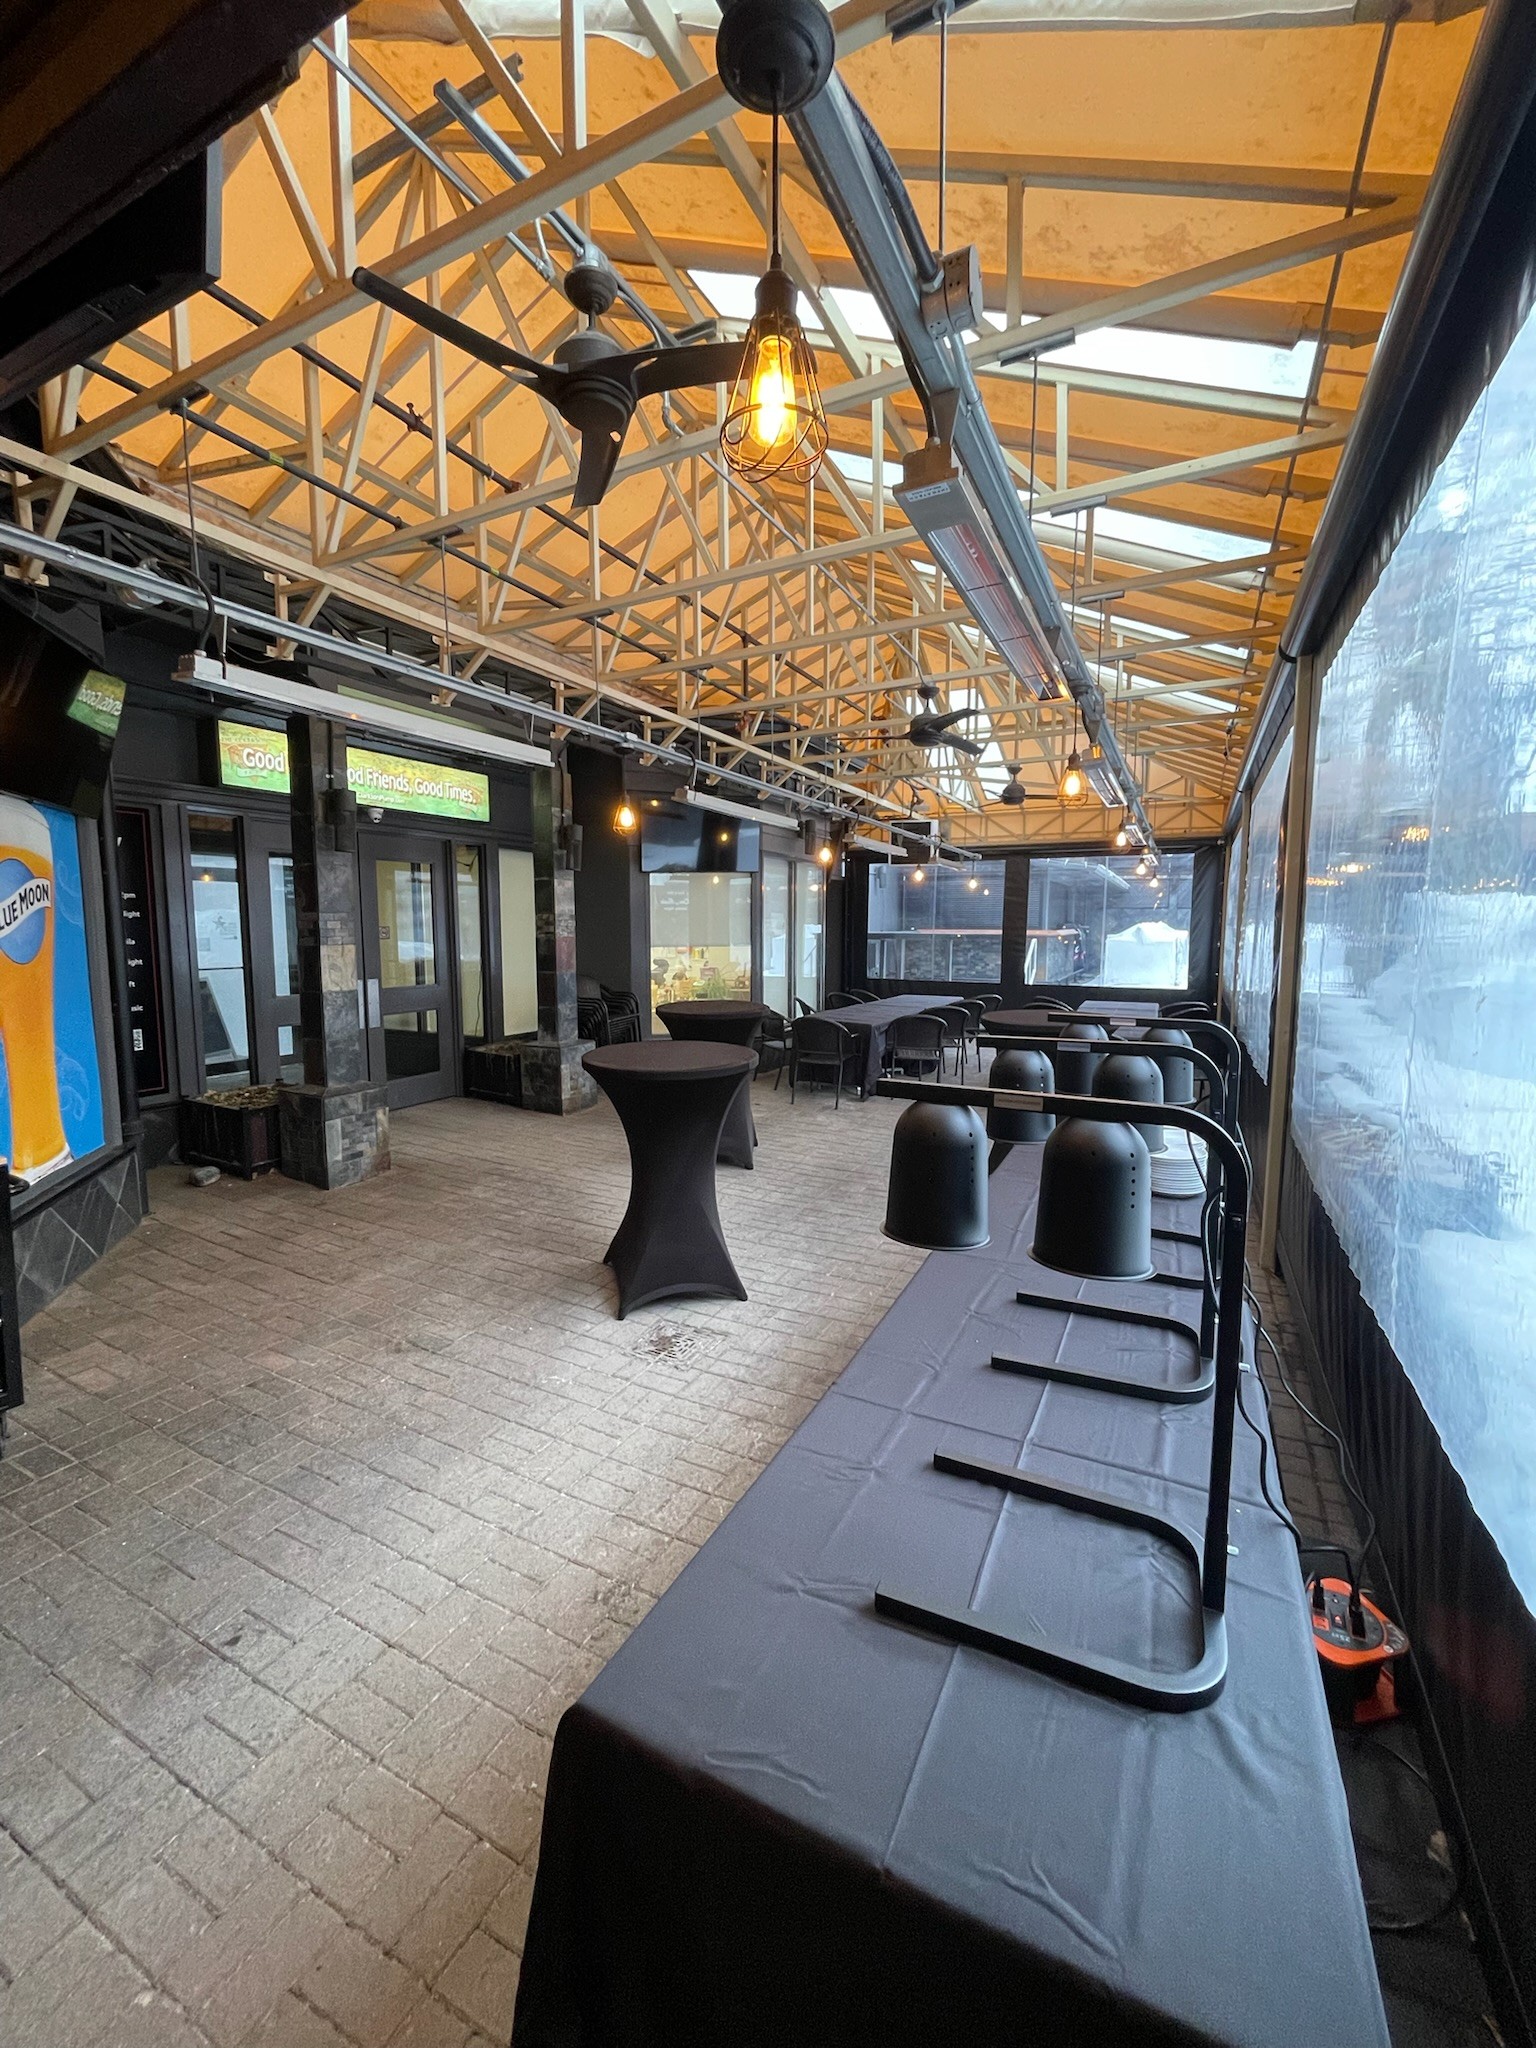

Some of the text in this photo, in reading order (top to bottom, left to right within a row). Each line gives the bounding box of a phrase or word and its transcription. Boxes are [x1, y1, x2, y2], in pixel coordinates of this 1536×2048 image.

[243, 747, 285, 773] Good
[366, 767, 413, 795] Friends,
[415, 777, 443, 798] Good
[444, 781, 477, 804] Times.
[19, 883, 49, 915] MOON
